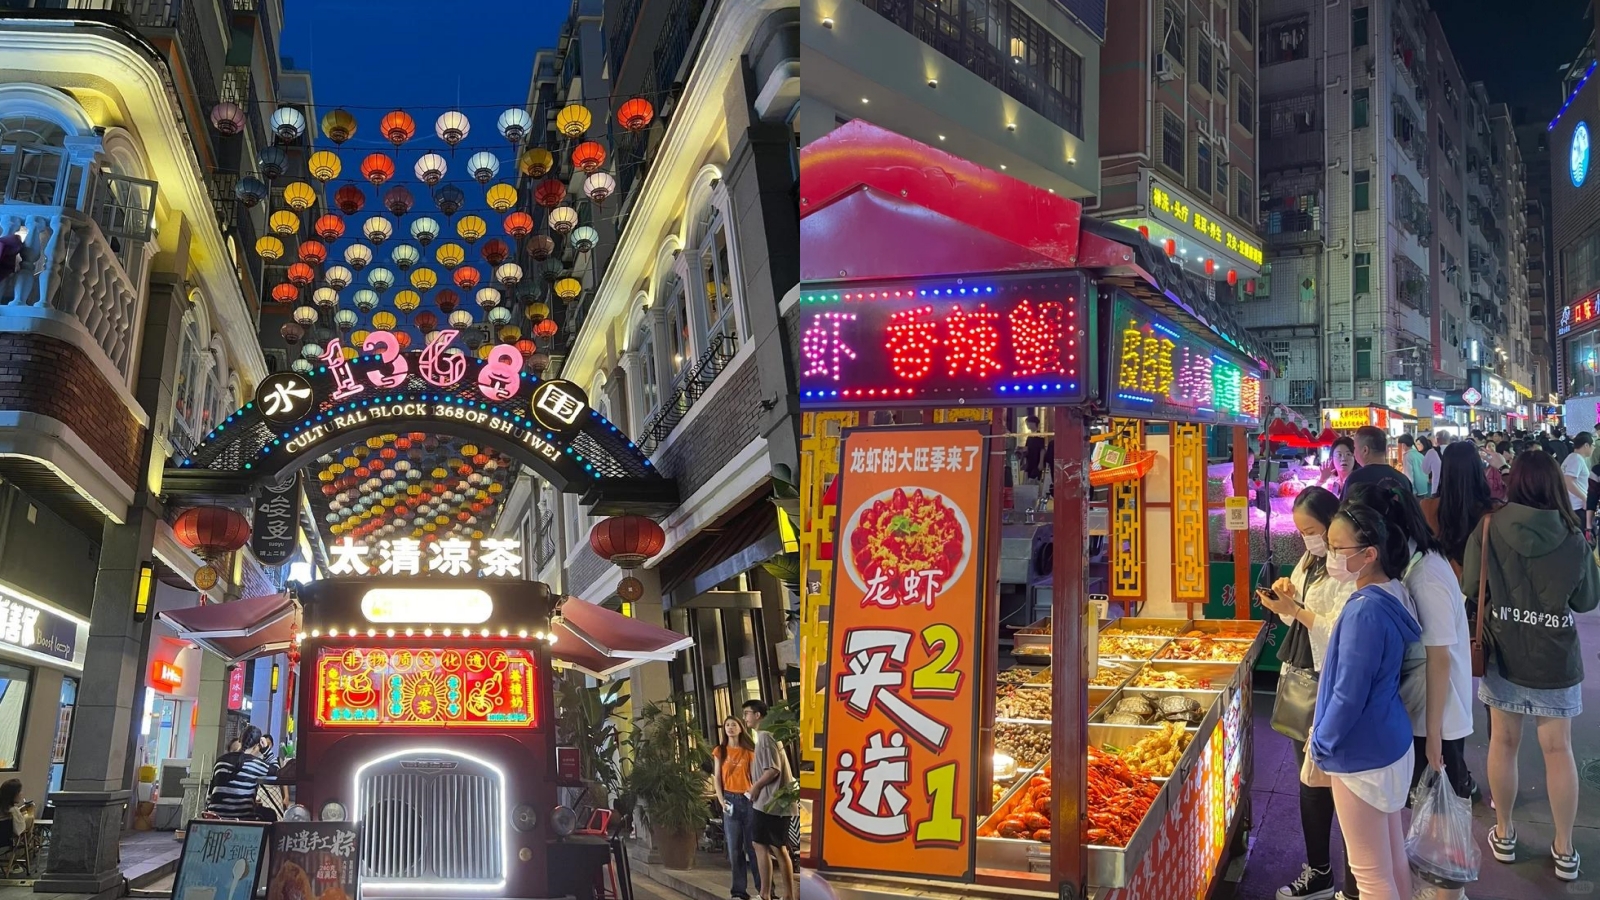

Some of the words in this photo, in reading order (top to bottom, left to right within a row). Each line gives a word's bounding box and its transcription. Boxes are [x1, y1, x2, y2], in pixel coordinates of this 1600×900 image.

[885, 300, 1065, 378] 香辣蟹
[263, 380, 311, 416] 水
[318, 329, 524, 401] 1368
[537, 384, 585, 424] 围
[285, 411, 367, 453] CULTURAL
[369, 403, 427, 418] BLOCK
[489, 417, 562, 462] SHUIWEI
[850, 445, 980, 474] 龙虾的大旺季来了
[861, 565, 944, 607] 龙虾
[344, 652, 507, 669] 非物质文化遗产
[417, 681, 434, 715] 凉茶
